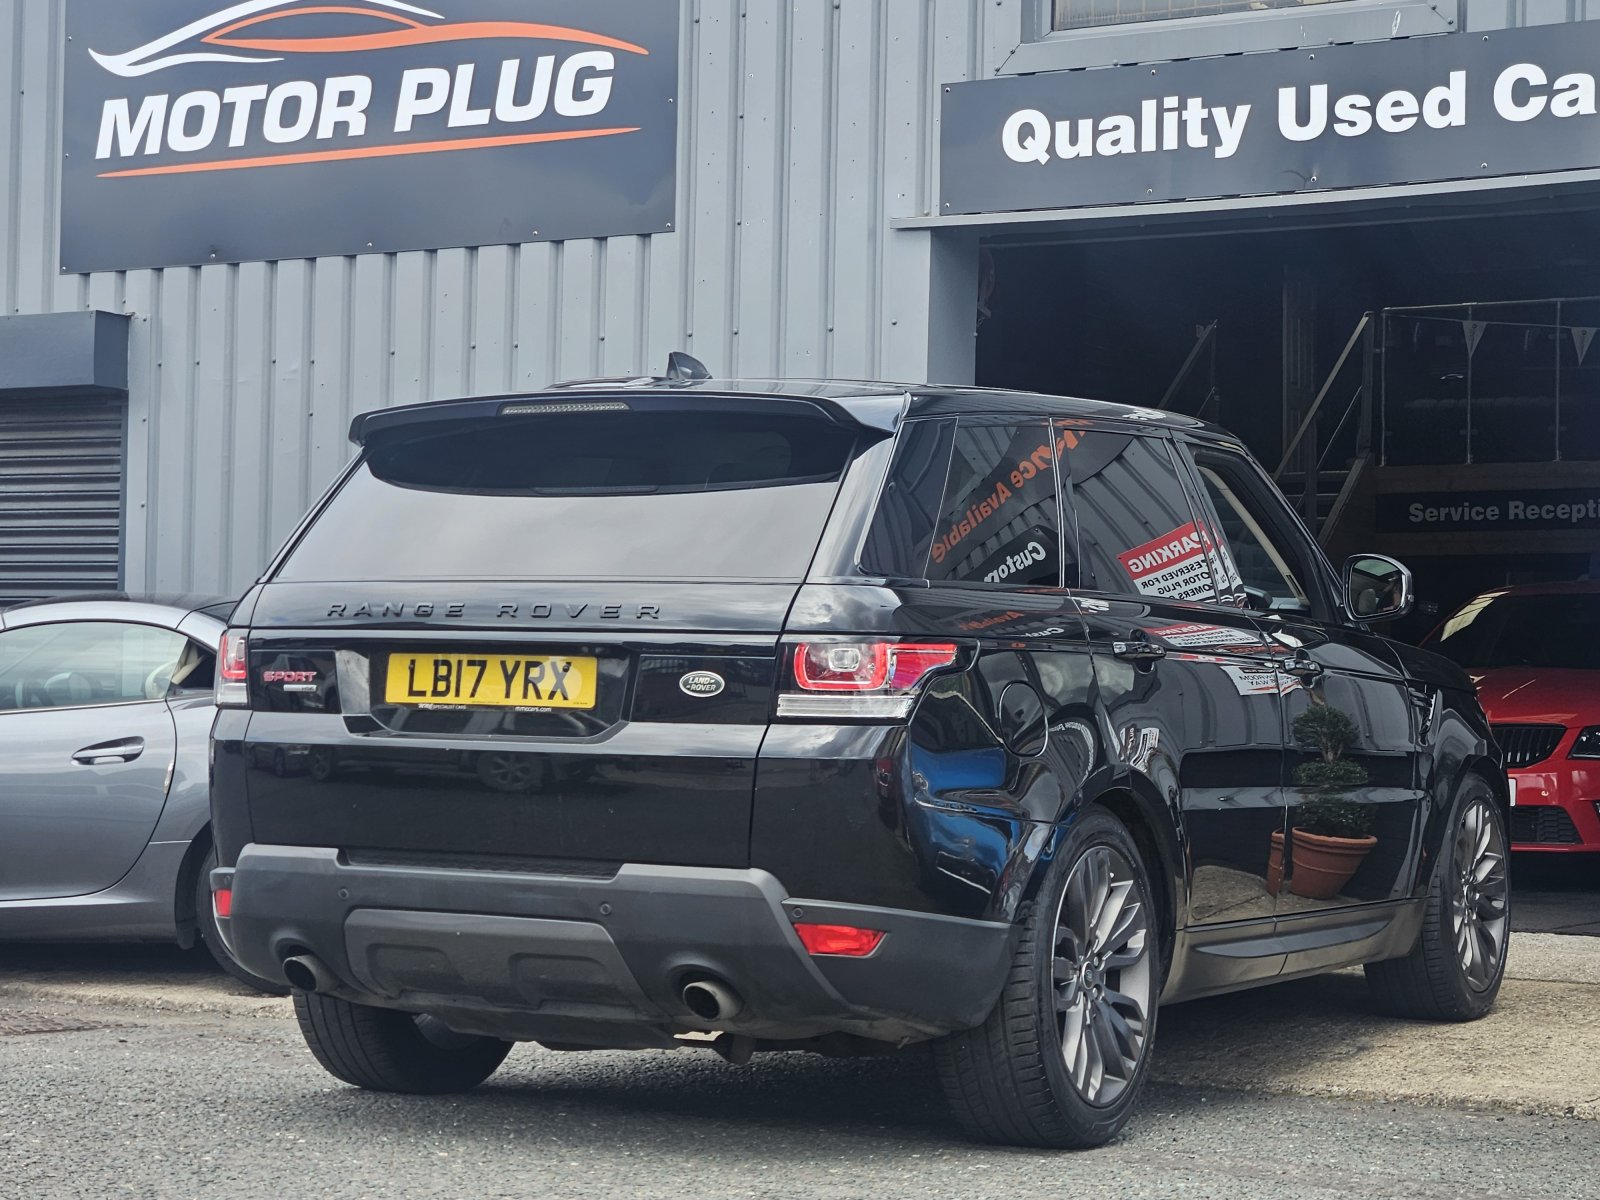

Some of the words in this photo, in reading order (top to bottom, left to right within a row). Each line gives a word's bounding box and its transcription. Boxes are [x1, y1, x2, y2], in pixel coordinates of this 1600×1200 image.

[95, 75, 372, 160] MOTOR
[393, 51, 615, 133] PLUG
[1001, 94, 1252, 166] Quality
[1276, 70, 1466, 142] Used
[1408, 502, 1500, 523] Service
[326, 602, 466, 618] RANGE
[496, 603, 661, 619] ROVER
[263, 671, 317, 682] SPORT
[407, 658, 488, 698] LB17
[500, 660, 572, 700] YRX
[689, 676, 711, 684] LAND
